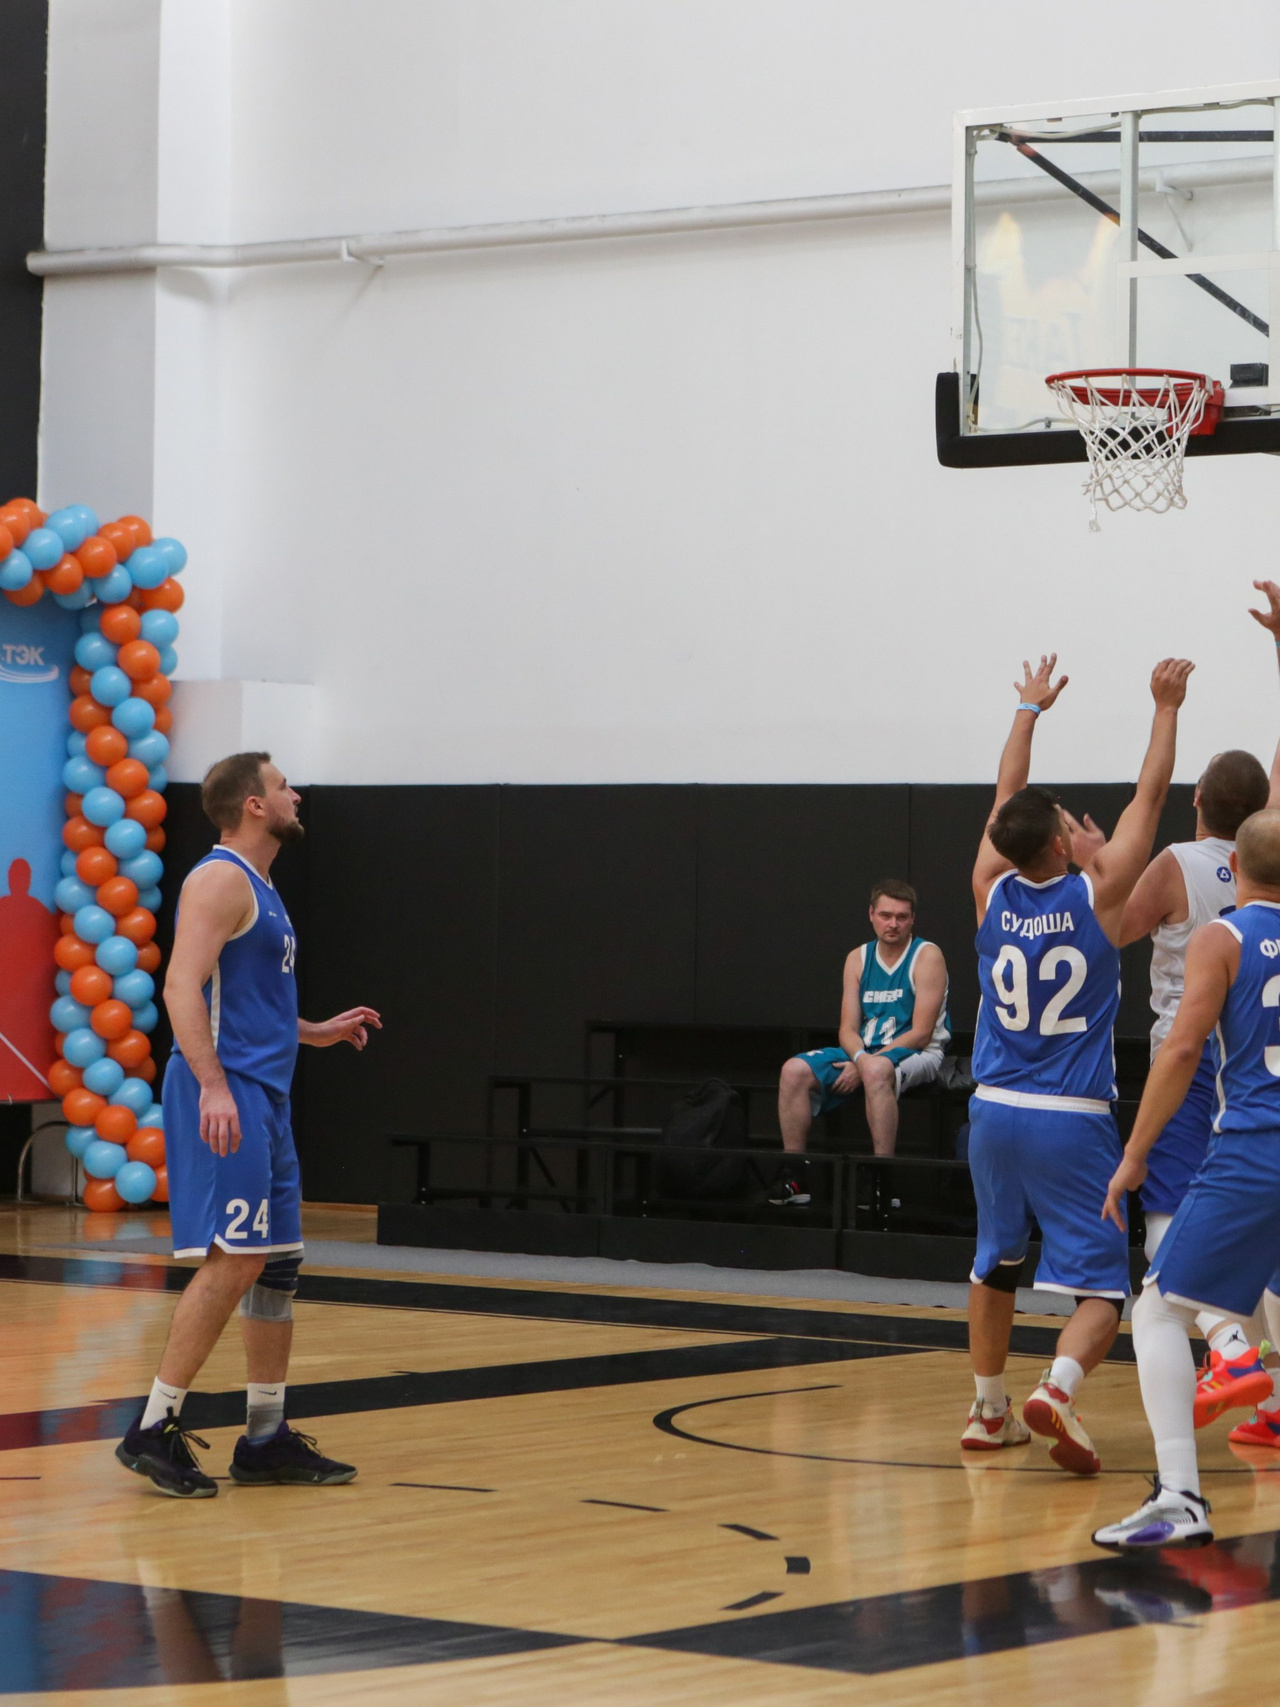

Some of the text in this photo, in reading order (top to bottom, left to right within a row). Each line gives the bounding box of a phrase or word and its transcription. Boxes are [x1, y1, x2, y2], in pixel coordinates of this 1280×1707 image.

[2, 644, 46, 666] ТЭК
[1001, 910, 1075, 940] СУДОША
[991, 944, 1088, 1036] 92
[224, 1198, 269, 1240] 24
